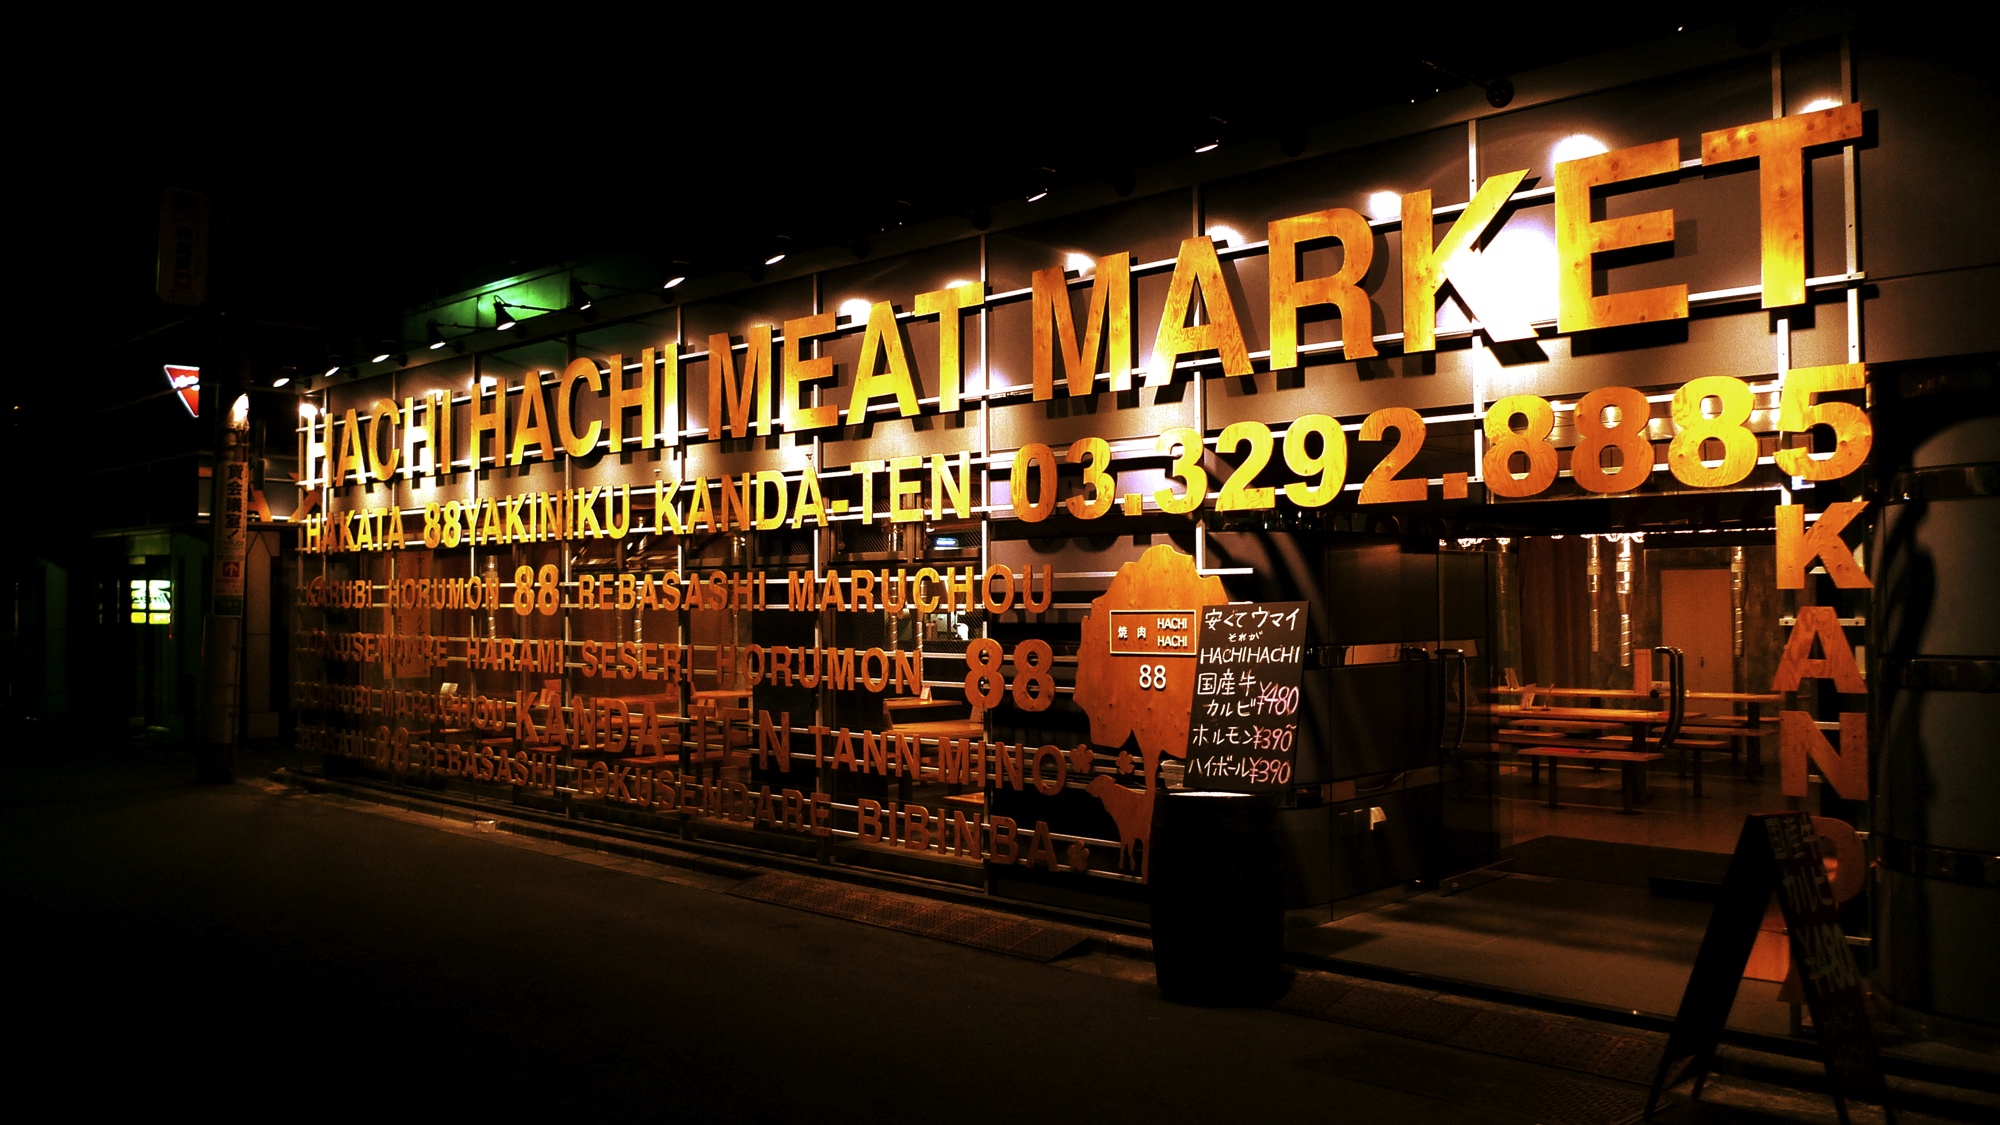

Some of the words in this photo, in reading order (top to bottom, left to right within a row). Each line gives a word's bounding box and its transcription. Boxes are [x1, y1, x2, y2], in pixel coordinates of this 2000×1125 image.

[306, 389, 452, 491] HACHI
[470, 342, 679, 470] HACHI
[708, 280, 985, 441] MEAT
[1031, 102, 1864, 401] MARKET
[306, 505, 405, 554] HAKATA
[655, 450, 971, 535] KANDA-TEN
[388, 576, 500, 610] HORUMON
[514, 564, 560, 616] 88
[578, 570, 766, 611] REBASASHI
[788, 564, 1053, 614] MARUCHOU
[1157, 617, 1188, 630] HACHI
[1157, 635, 1188, 648] HACHI
[467, 636, 564, 674] HARAMI
[582, 640, 694, 684] SESERI
[716, 644, 922, 695] HORUMON
[965, 638, 1055, 712] 88
[1139, 664, 1167, 690] 88
[1197, 668, 1257, 697] 国産牛
[1206, 698, 1257, 717] カルビ
[382, 687, 506, 732] MARUCHOU
[808, 725, 921, 778] TANN
[938, 737, 1067, 796] MINO
[375, 725, 410, 774] 88
[420, 741, 556, 793] REBASASHI
[573, 759, 831, 837] TOKUSENDARE
[858, 798, 1059, 872] BIBINBA
